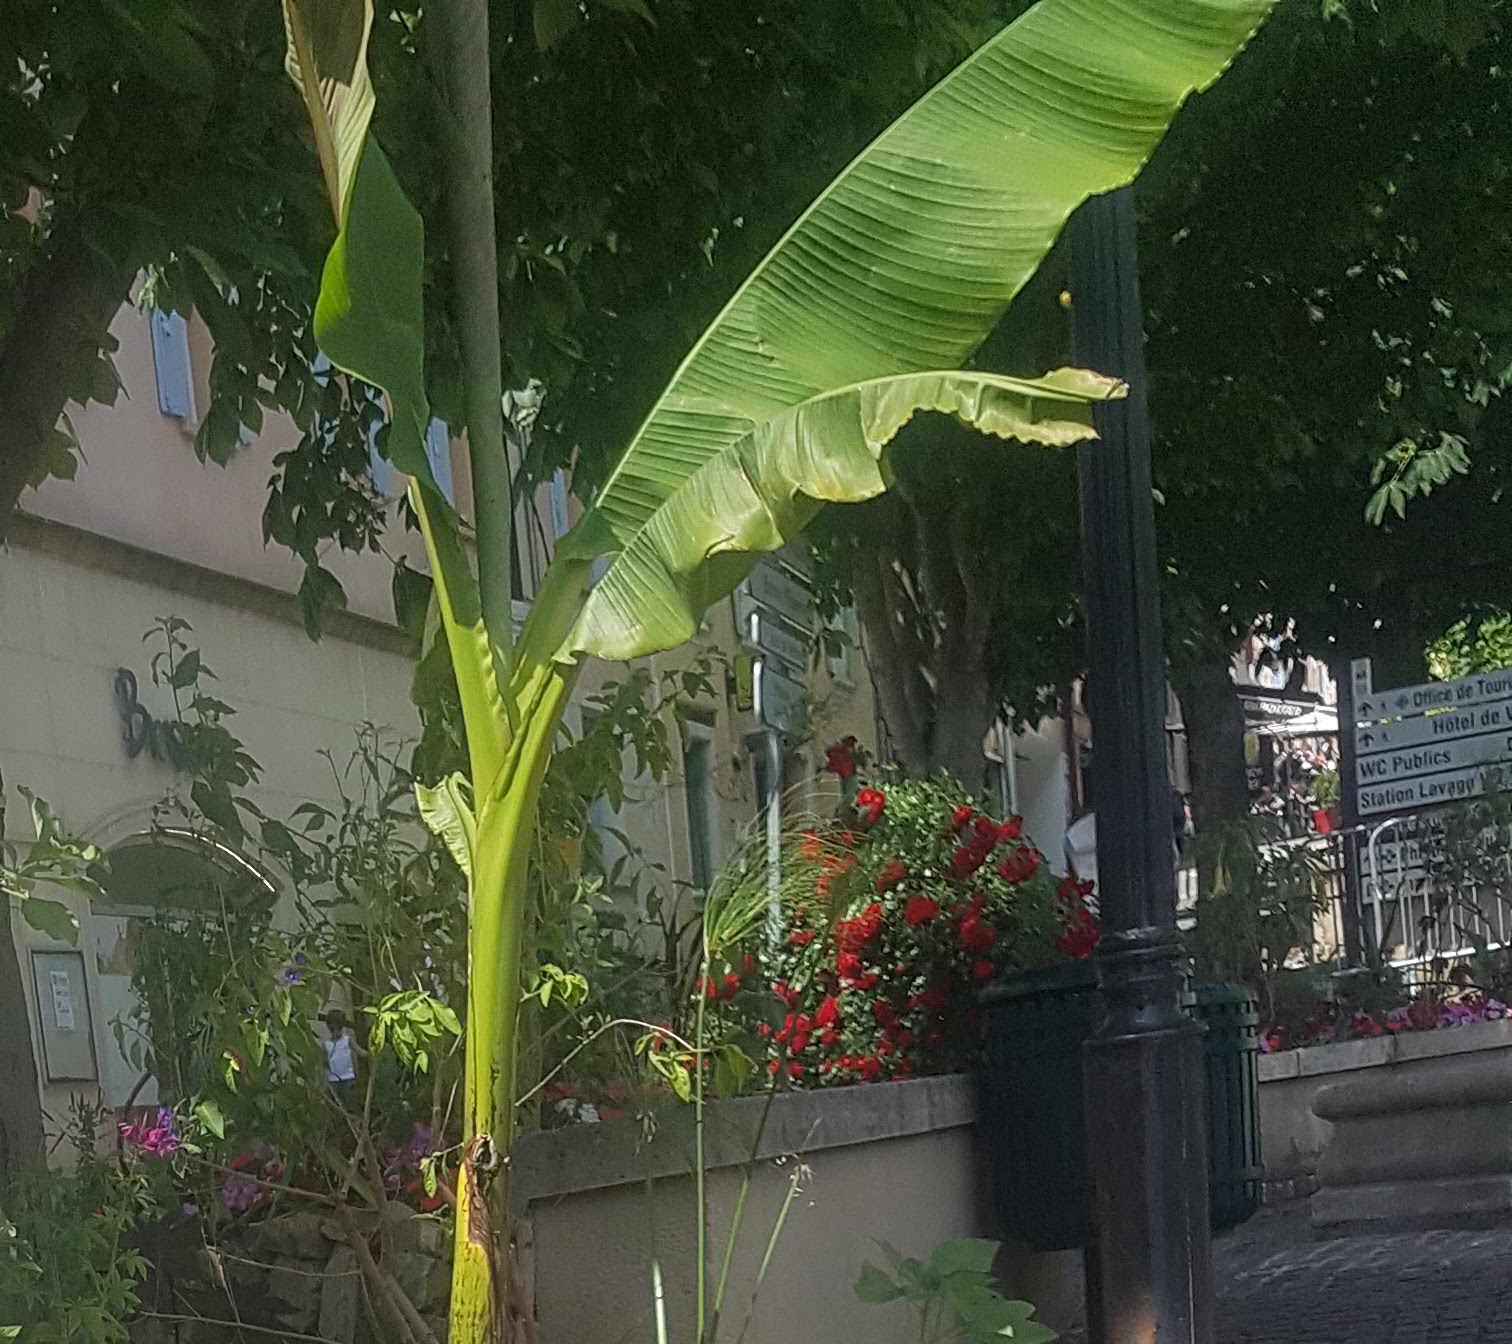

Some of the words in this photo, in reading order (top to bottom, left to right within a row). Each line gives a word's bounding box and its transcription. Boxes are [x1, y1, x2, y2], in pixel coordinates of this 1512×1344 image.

[1413, 685, 1452, 706] Office
[1456, 684, 1474, 699] de
[1481, 710, 1500, 724] de
[1359, 759, 1387, 777] WC
[1392, 750, 1451, 773] Publics
[1360, 788, 1414, 809] Station
